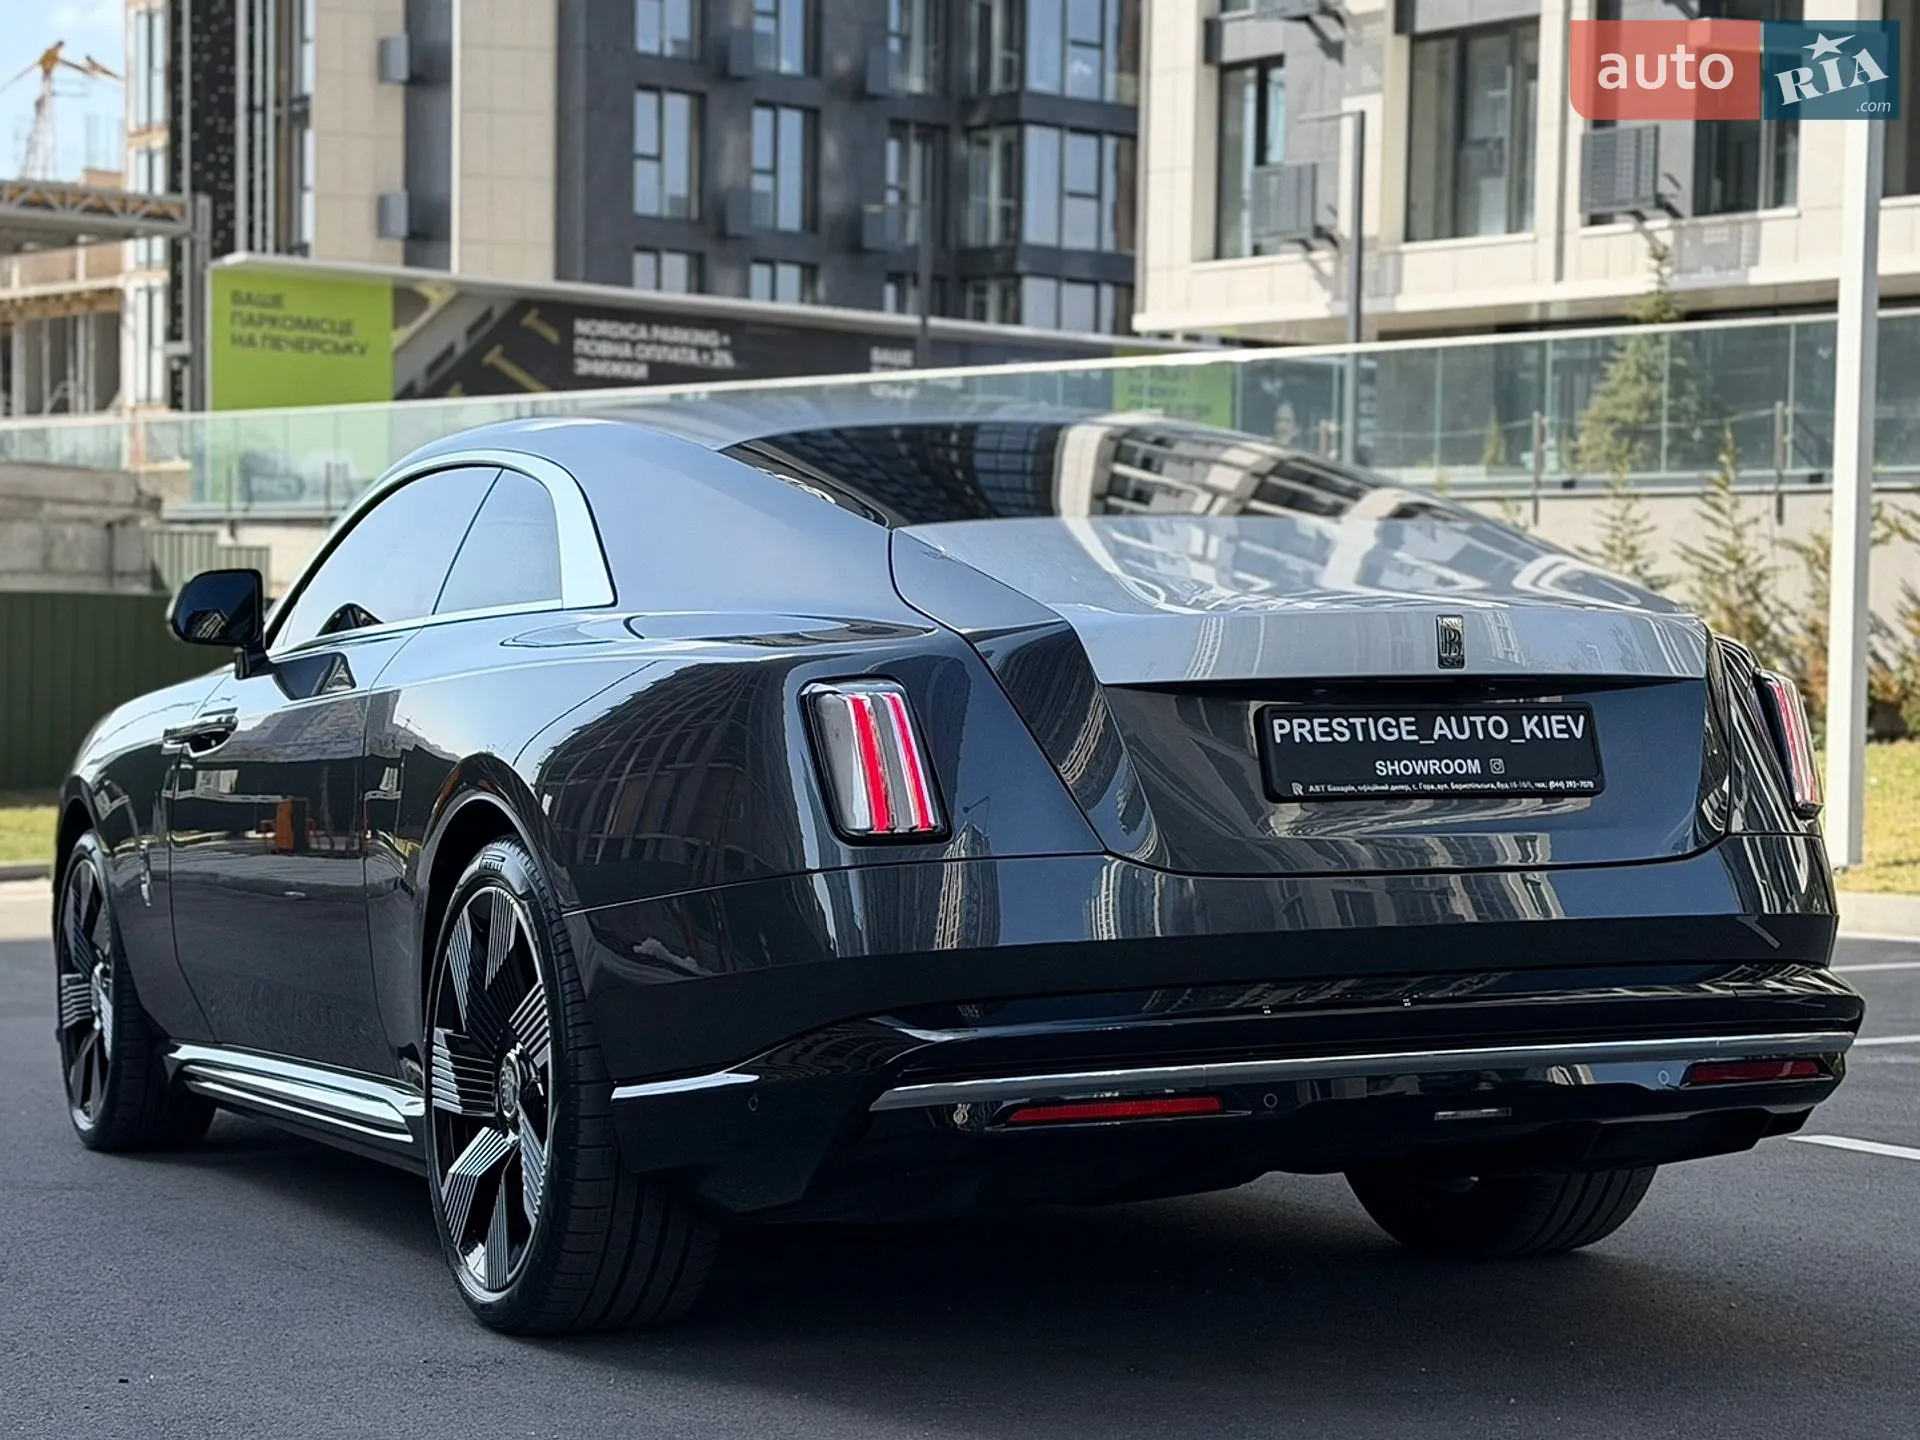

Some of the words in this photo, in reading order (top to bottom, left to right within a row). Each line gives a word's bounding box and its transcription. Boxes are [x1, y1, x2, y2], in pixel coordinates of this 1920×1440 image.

[230, 289, 285, 310] ВАШЕ
[230, 310, 355, 336] ПАРКОМІСЦЕ
[573, 317, 648, 340] NORDICA
[650, 324, 720, 347] PARKING
[230, 332, 257, 348] НА
[1272, 714, 1586, 745] PRESTIGE_AUTO_KIEV
[1375, 758, 1482, 777] SHOWROOM
